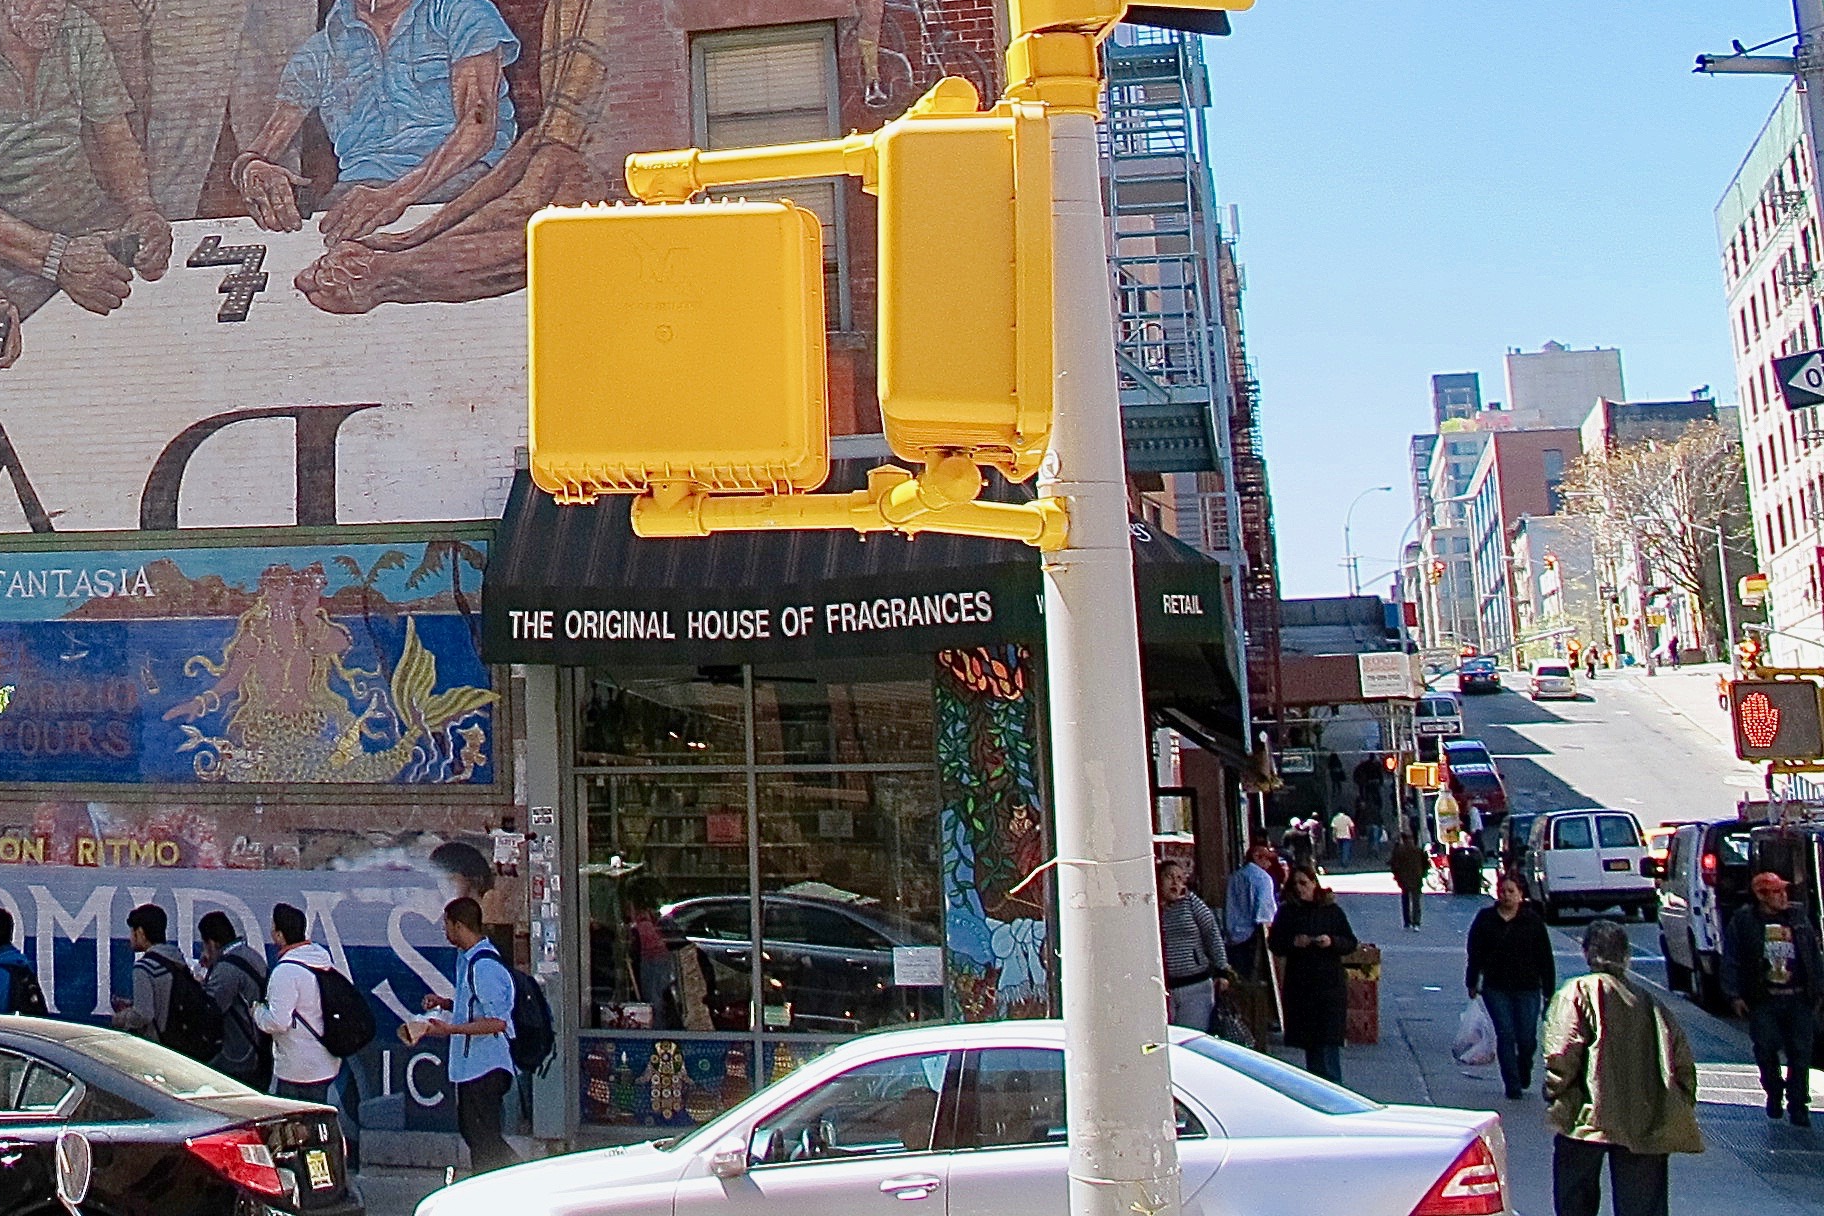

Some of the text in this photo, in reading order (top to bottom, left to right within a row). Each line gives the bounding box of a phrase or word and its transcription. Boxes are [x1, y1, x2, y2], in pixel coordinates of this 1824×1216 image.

[509, 591, 993, 639] THE ORIGINAL HOUSE OF FRAGRANCES
[1162, 594, 1204, 615] RETAIL
[78, 839, 180, 868] RITMO
